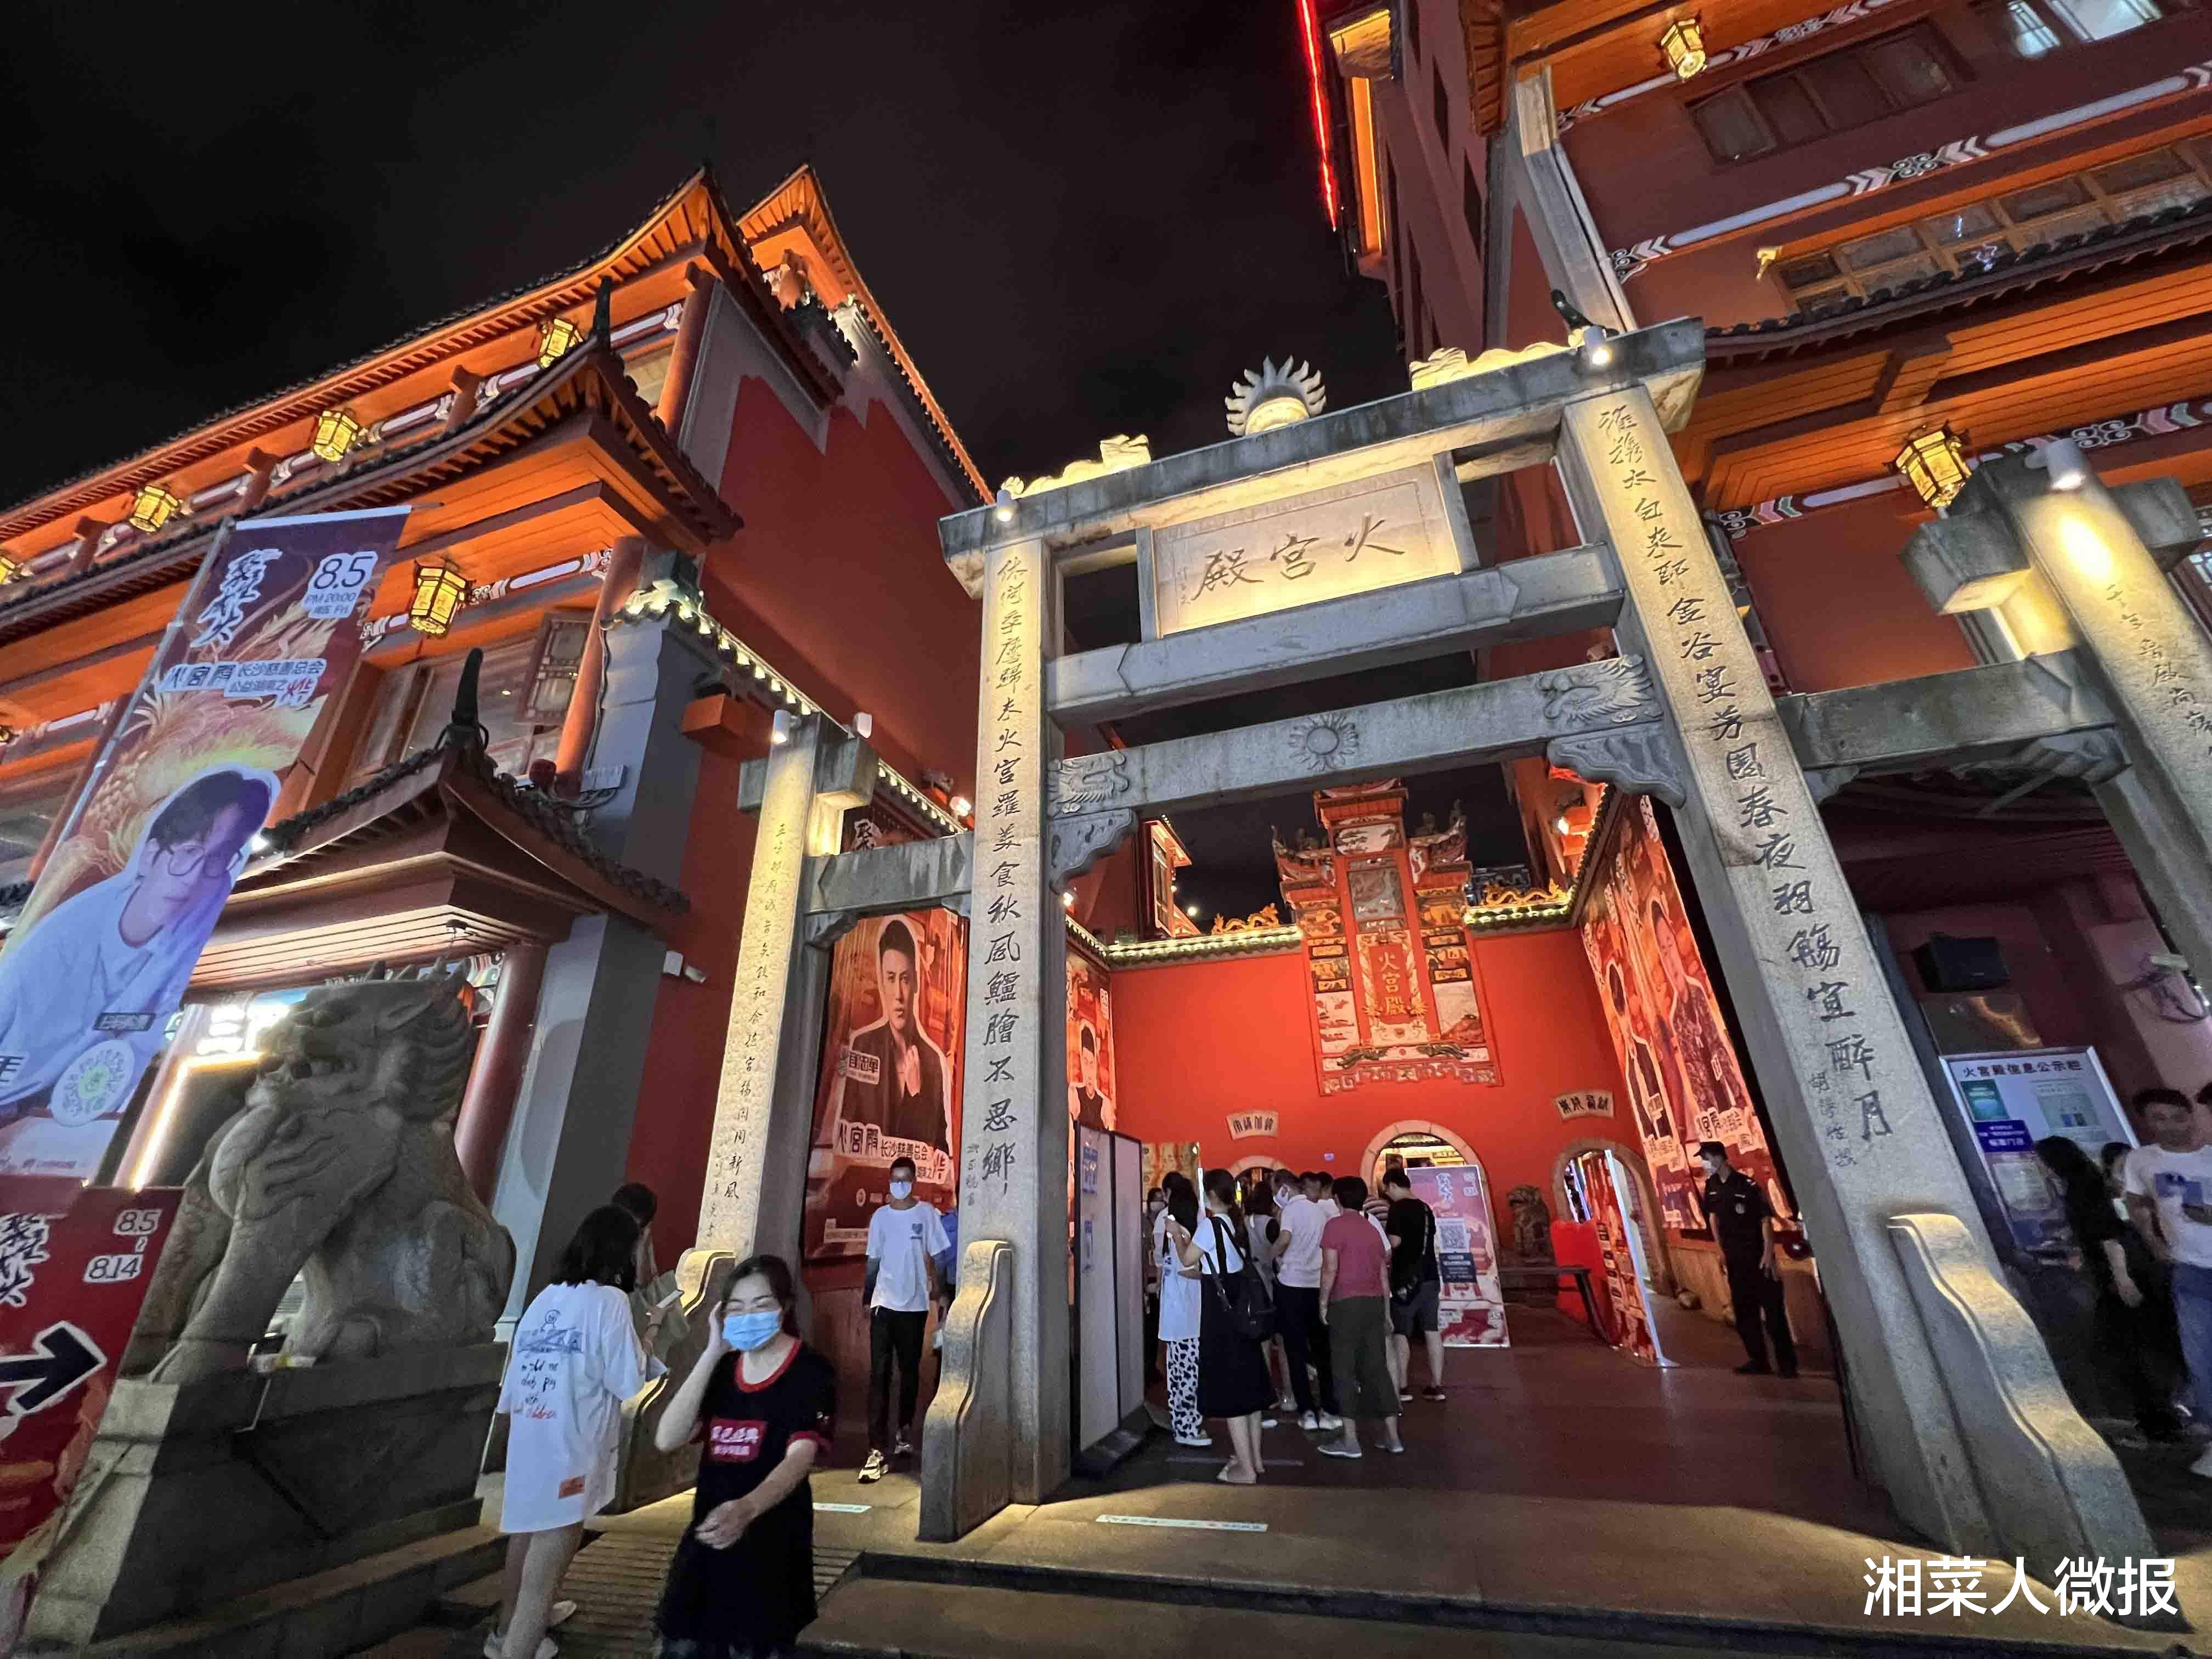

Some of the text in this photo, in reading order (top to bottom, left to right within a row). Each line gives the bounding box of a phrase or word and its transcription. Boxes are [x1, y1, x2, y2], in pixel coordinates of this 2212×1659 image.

[314, 556, 374, 590] 8.5
[325, 592, 357, 602] 20:00
[1963, 1060, 2084, 1077] 火宫殿信息公示栏
[117, 1211, 158, 1233] 8.5
[88, 1257, 139, 1279] 8.14
